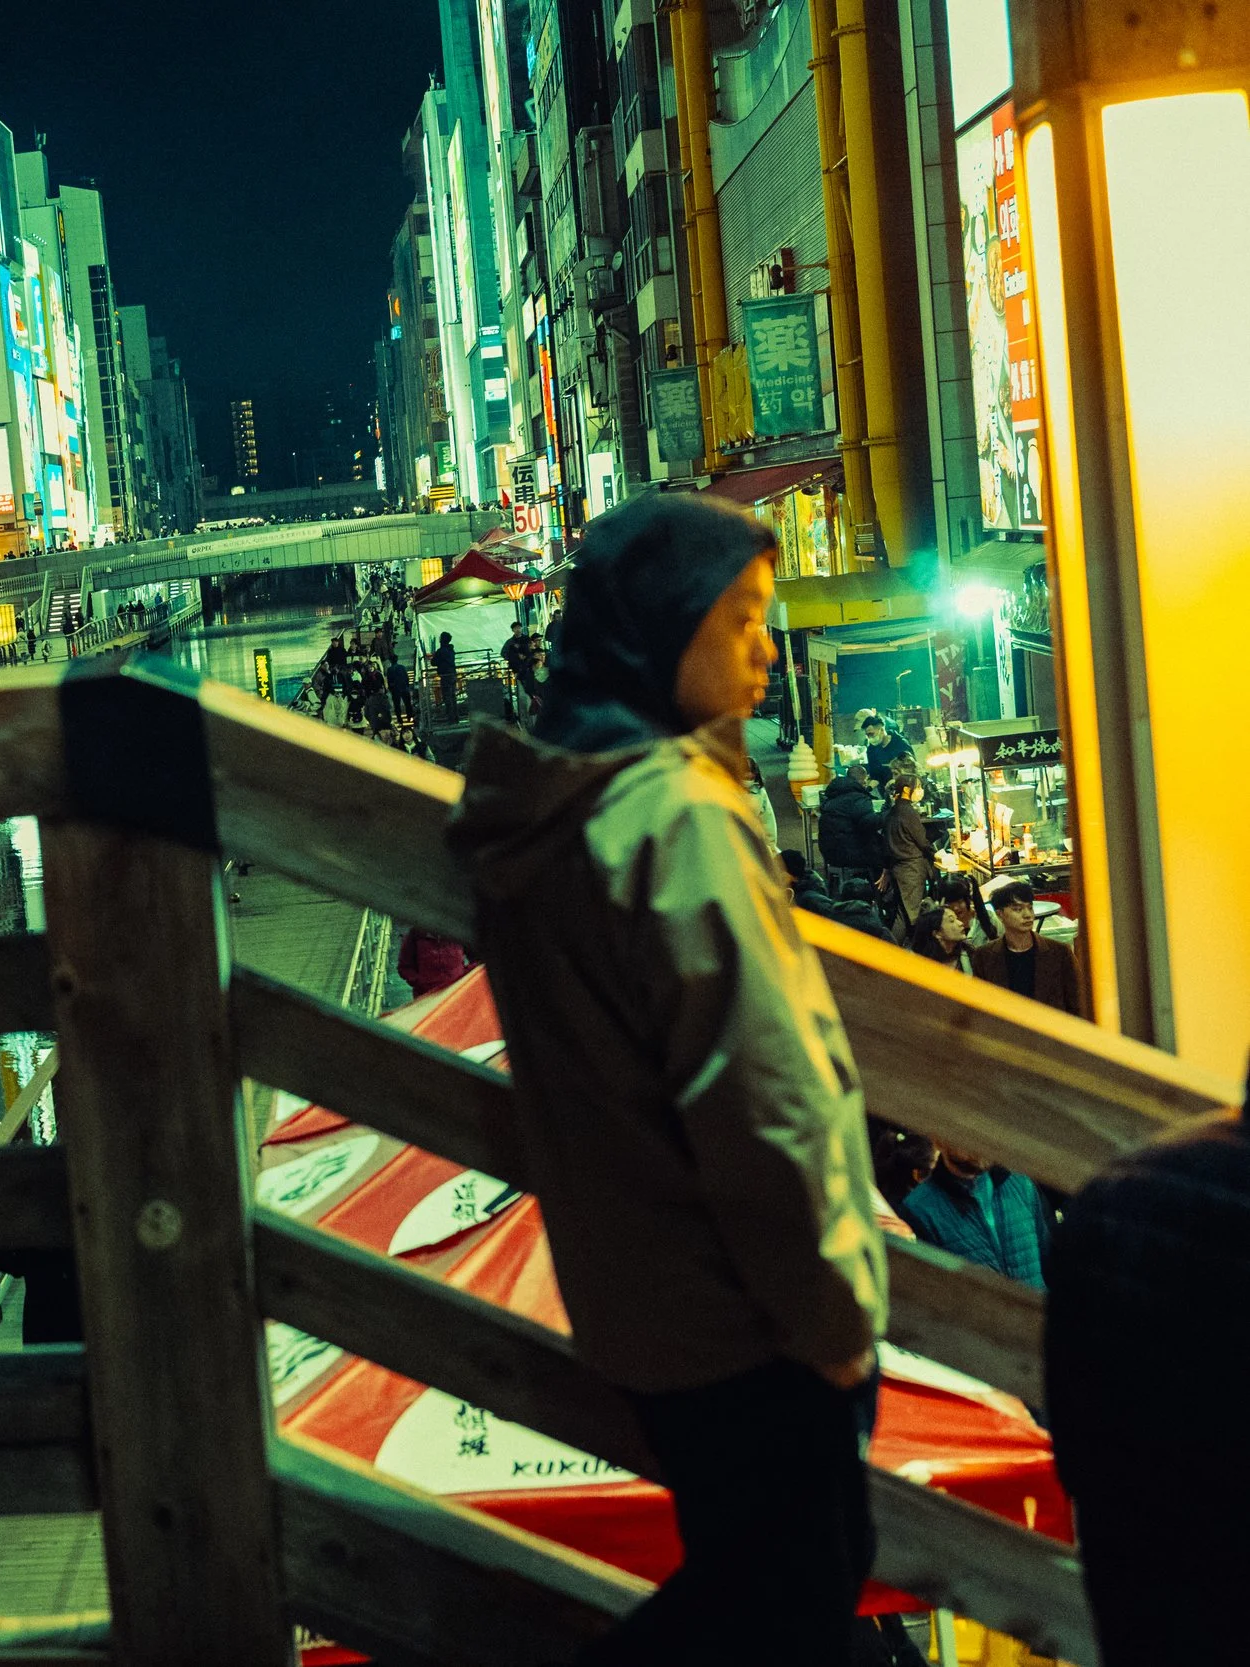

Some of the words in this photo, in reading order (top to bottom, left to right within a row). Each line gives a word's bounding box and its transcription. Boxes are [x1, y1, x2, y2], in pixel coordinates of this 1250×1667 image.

[751, 315, 813, 373] 薬
[656, 379, 698, 418] 薬
[756, 373, 815, 389] Medicine
[512, 465, 536, 506] 伝串
[514, 504, 541, 535] 50
